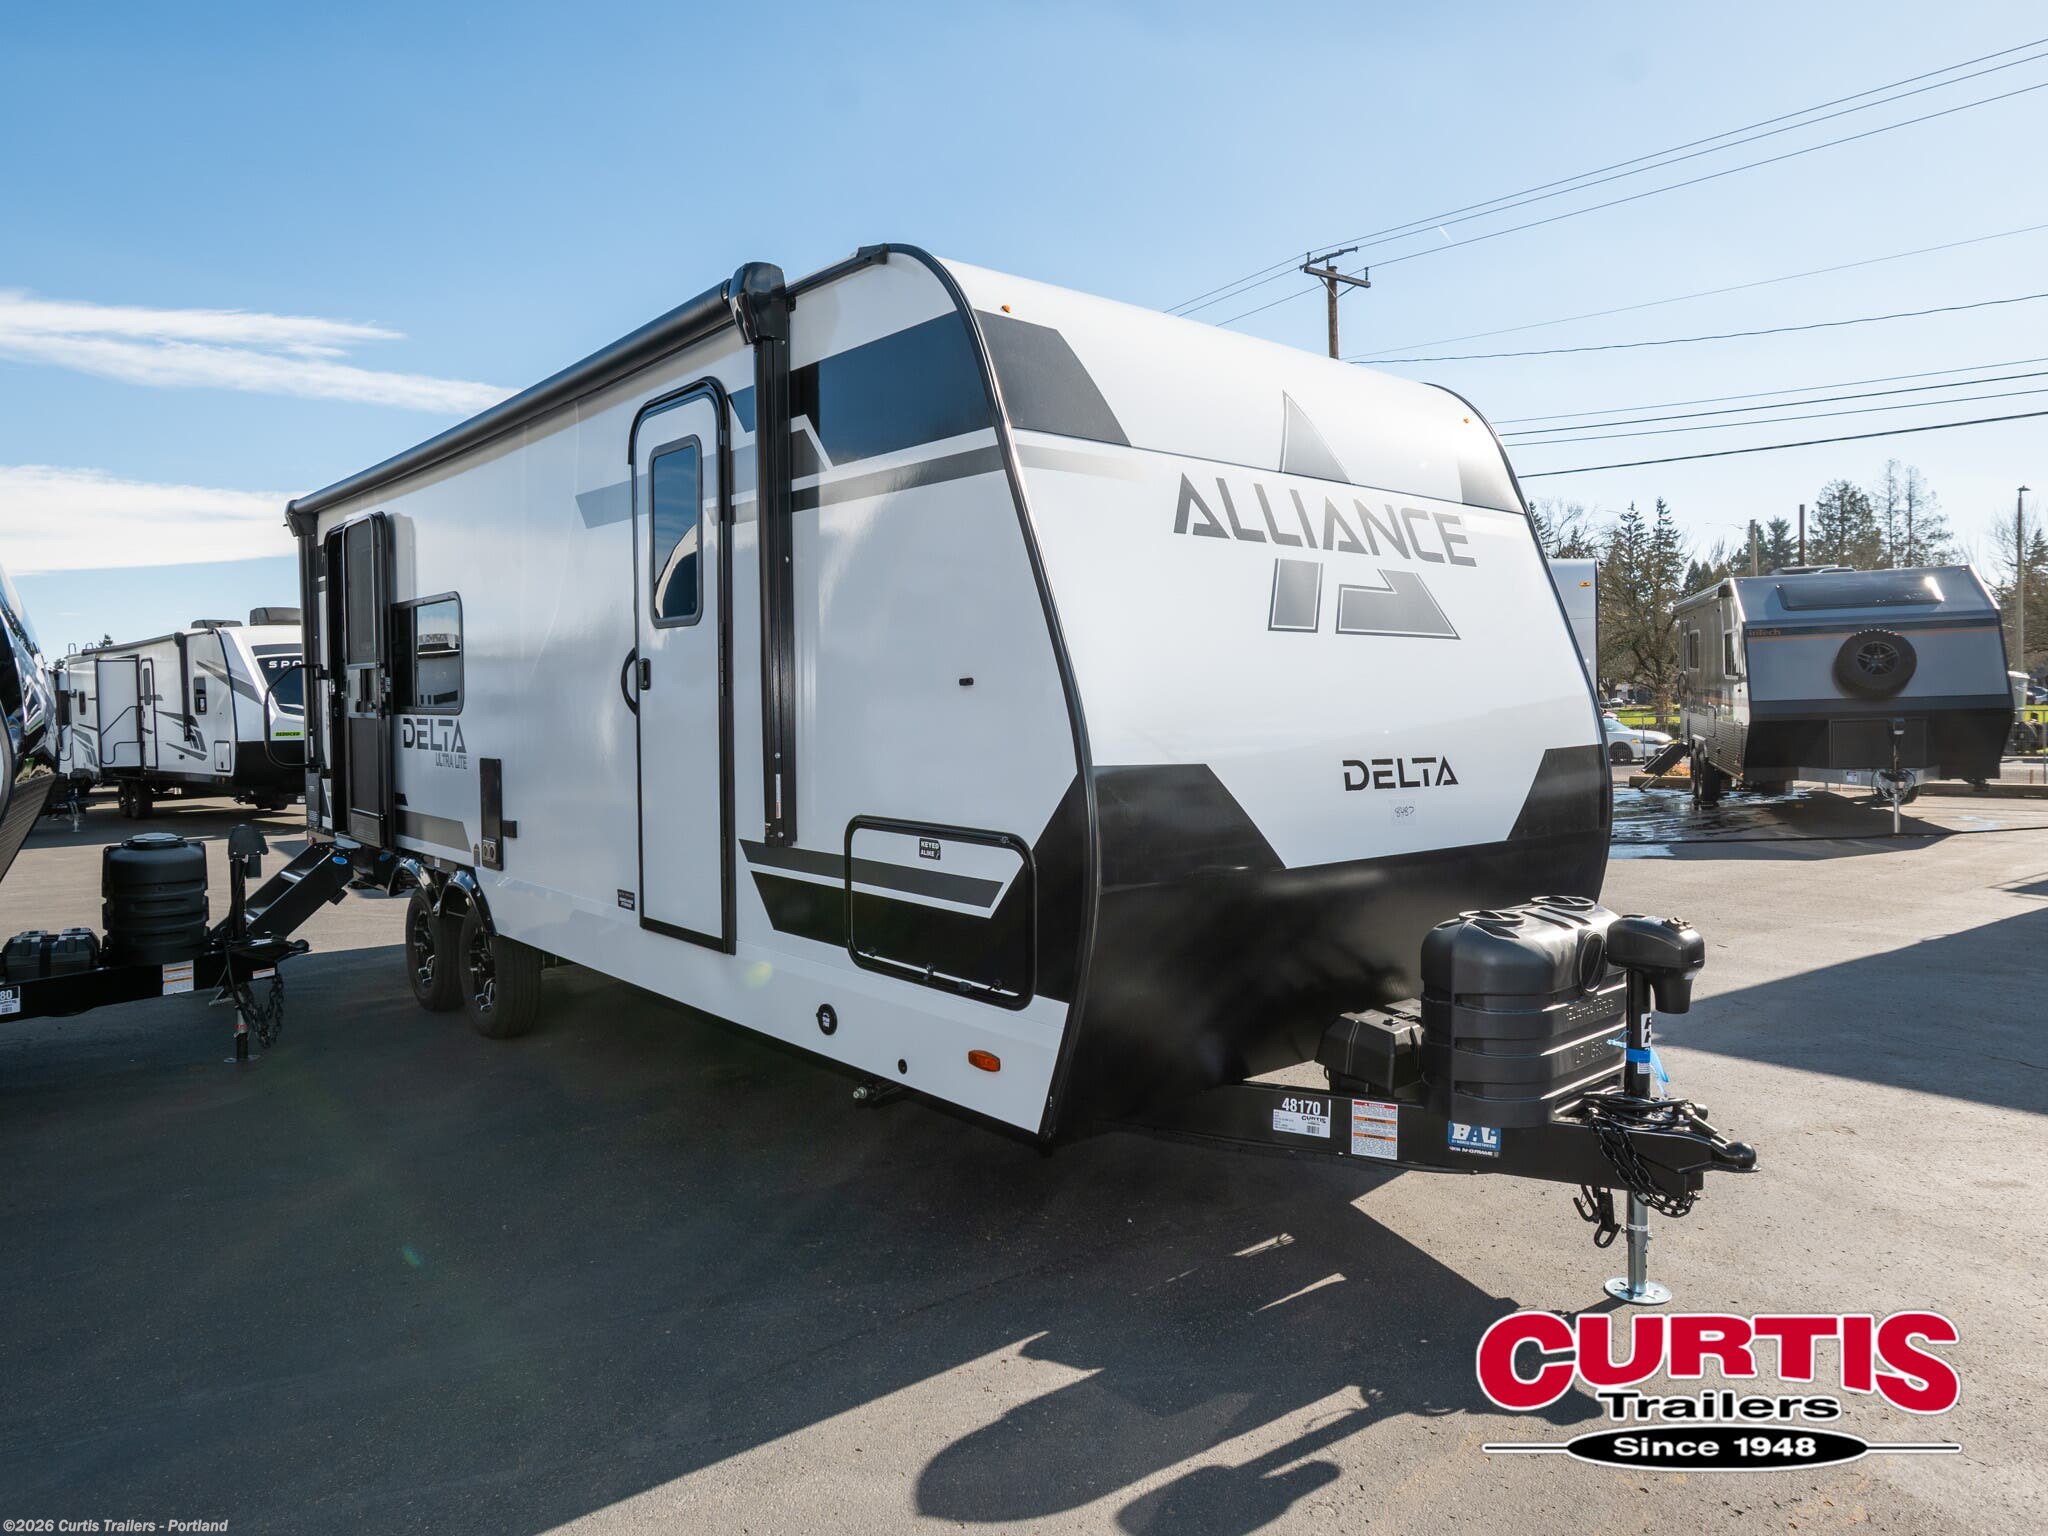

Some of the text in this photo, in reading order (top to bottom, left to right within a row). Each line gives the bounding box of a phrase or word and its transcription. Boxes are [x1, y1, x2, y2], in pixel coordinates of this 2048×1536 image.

[1173, 472, 1477, 567] ALLIANCE
[402, 717, 467, 753] DELTA
[1342, 755, 1459, 791] DELTA
[1281, 1097, 1321, 1116] 48170
[1452, 1123, 1497, 1145] BAL
